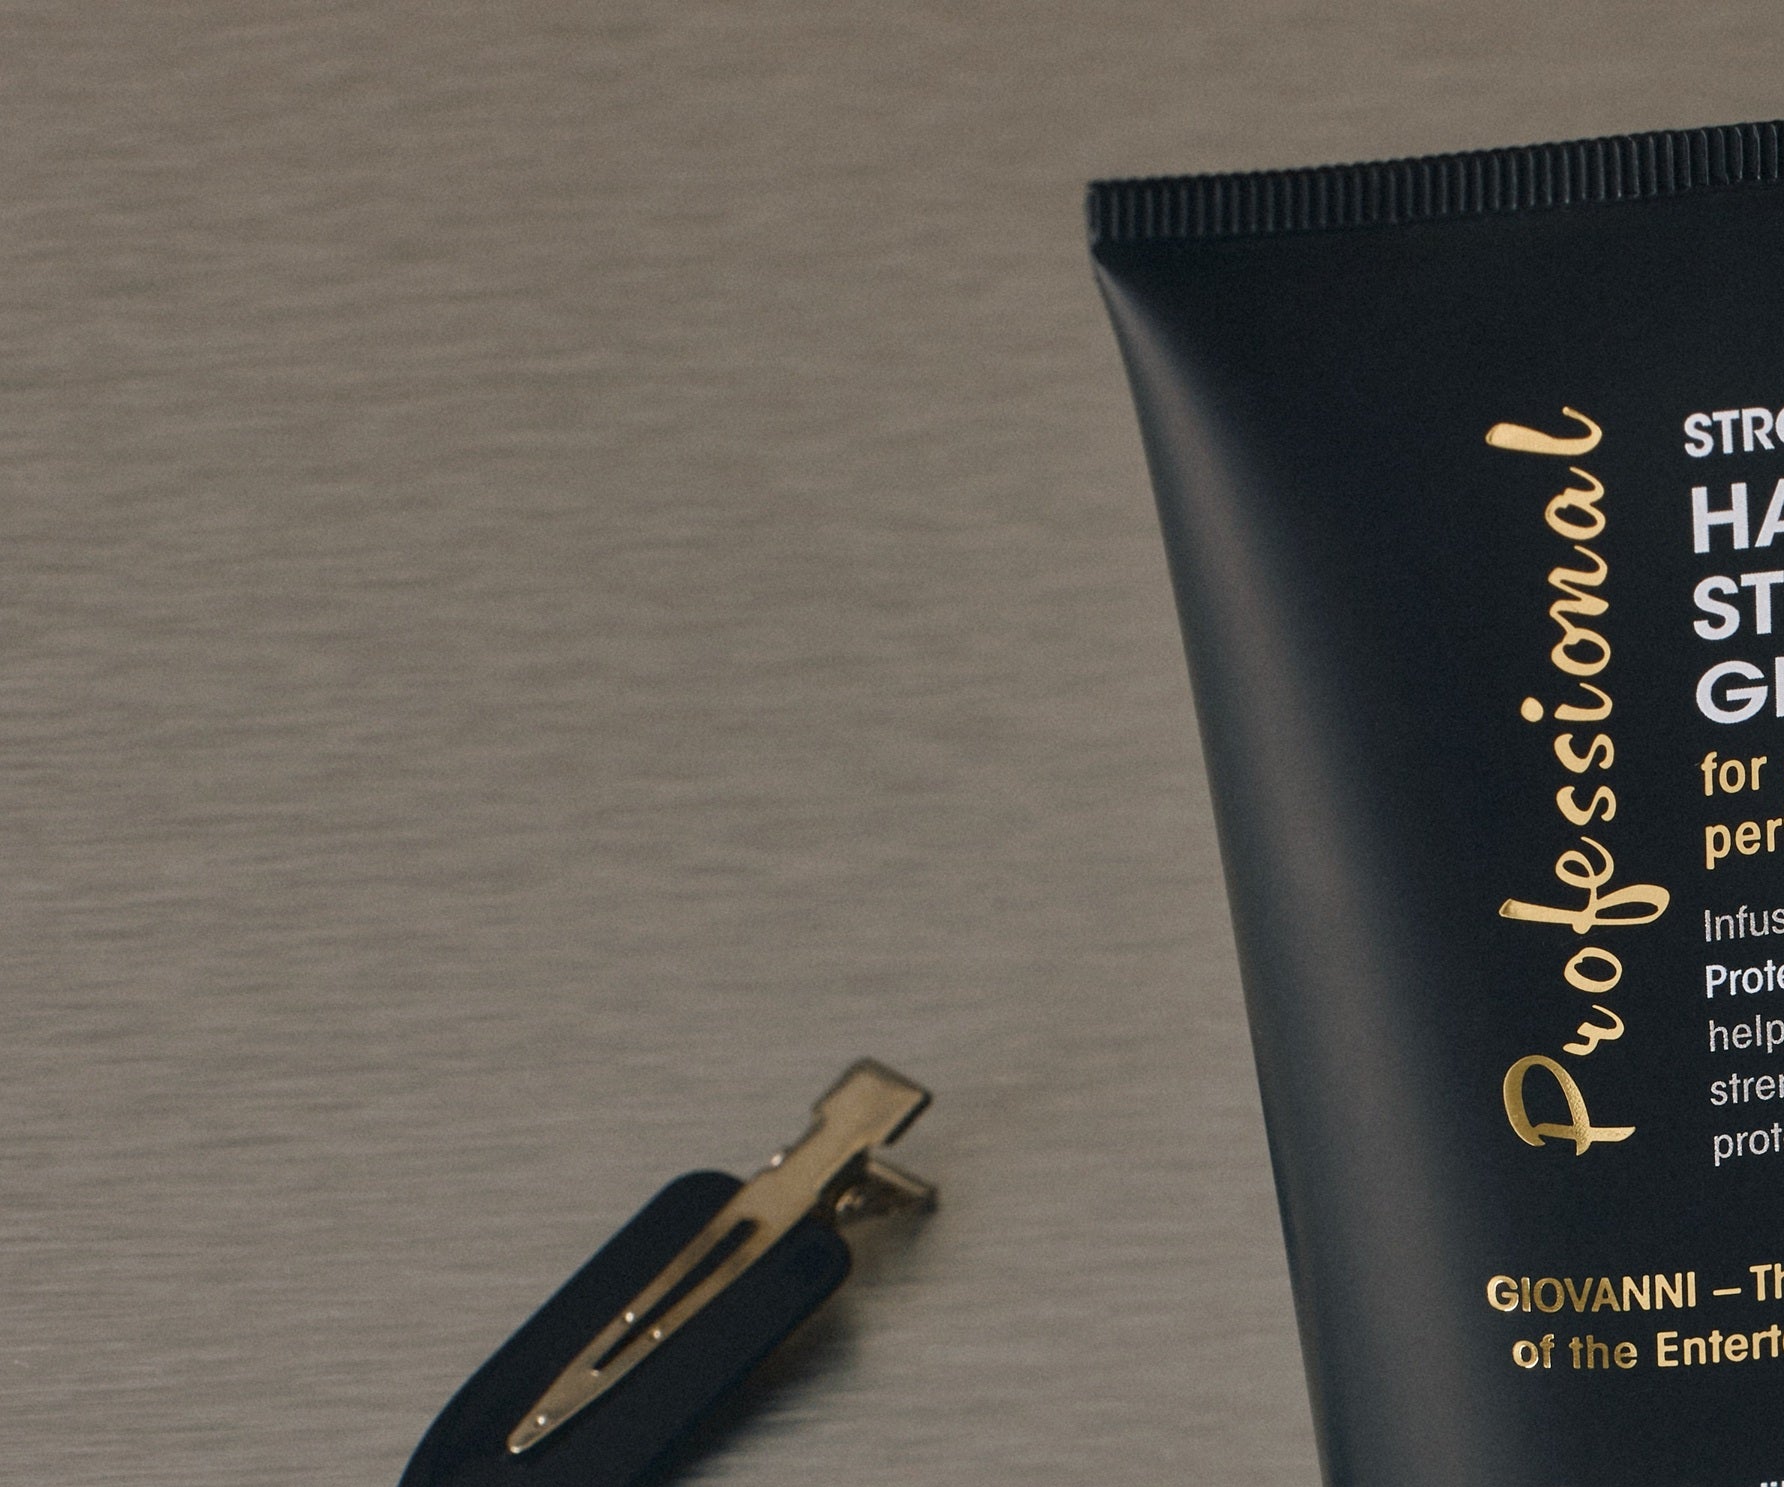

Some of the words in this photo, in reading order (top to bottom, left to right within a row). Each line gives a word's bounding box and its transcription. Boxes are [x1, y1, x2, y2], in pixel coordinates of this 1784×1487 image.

[1485, 406, 1671, 1156] Professional
[1700, 751, 1768, 797] for
[1486, 1271, 1697, 1313] GIOVANNI
[1511, 1333, 1555, 1370] of
[1568, 1334, 1639, 1370] the
